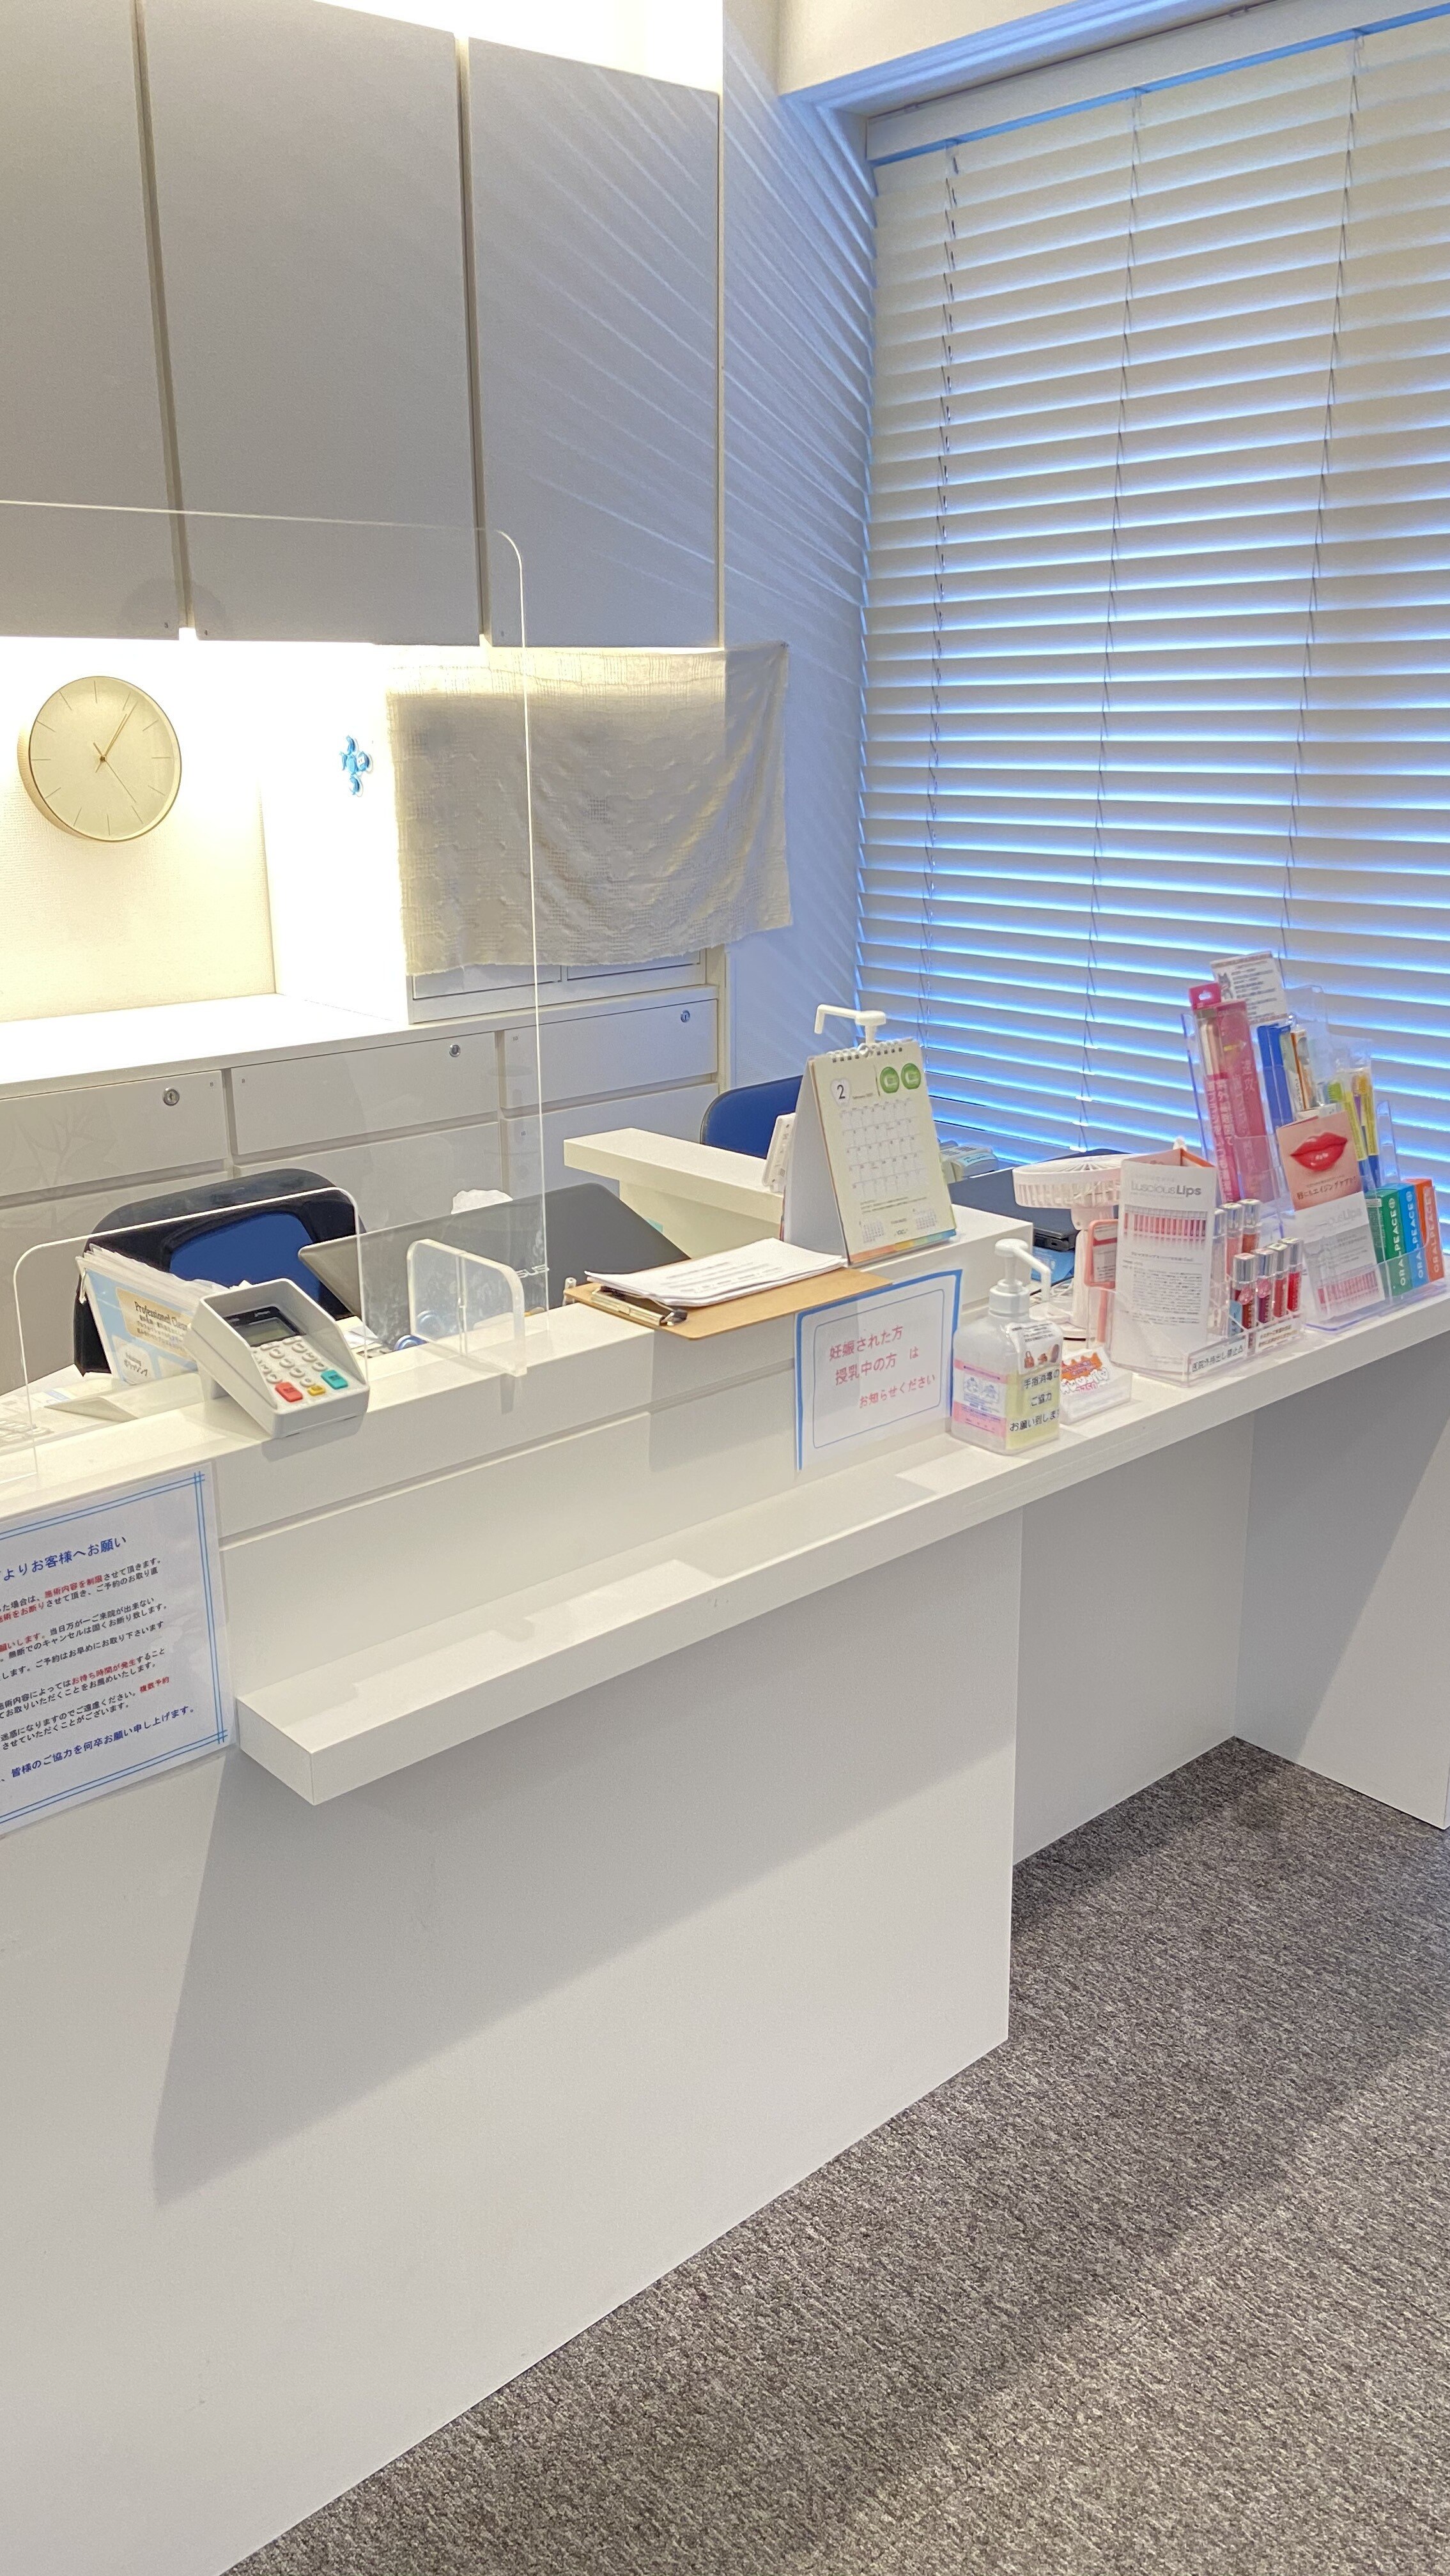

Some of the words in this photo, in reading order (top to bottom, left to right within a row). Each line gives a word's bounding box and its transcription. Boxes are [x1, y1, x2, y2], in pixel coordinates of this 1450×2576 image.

[837, 1084, 845, 1100] 2
[1389, 1209, 1406, 1287] ORALPEACE
[829, 1324, 903, 1361] 妊娠された方
[835, 1352, 897, 1386] 授乳中の方
[859, 1374, 935, 1409] お知らせください
[0, 1537, 127, 1581] よりお客様へお願い
[0, 1558, 160, 1613] た場合は、施術内容を制限させて頂きます。
[0, 1621, 164, 1682] します。ご予約はお早めにお取り下さいます
